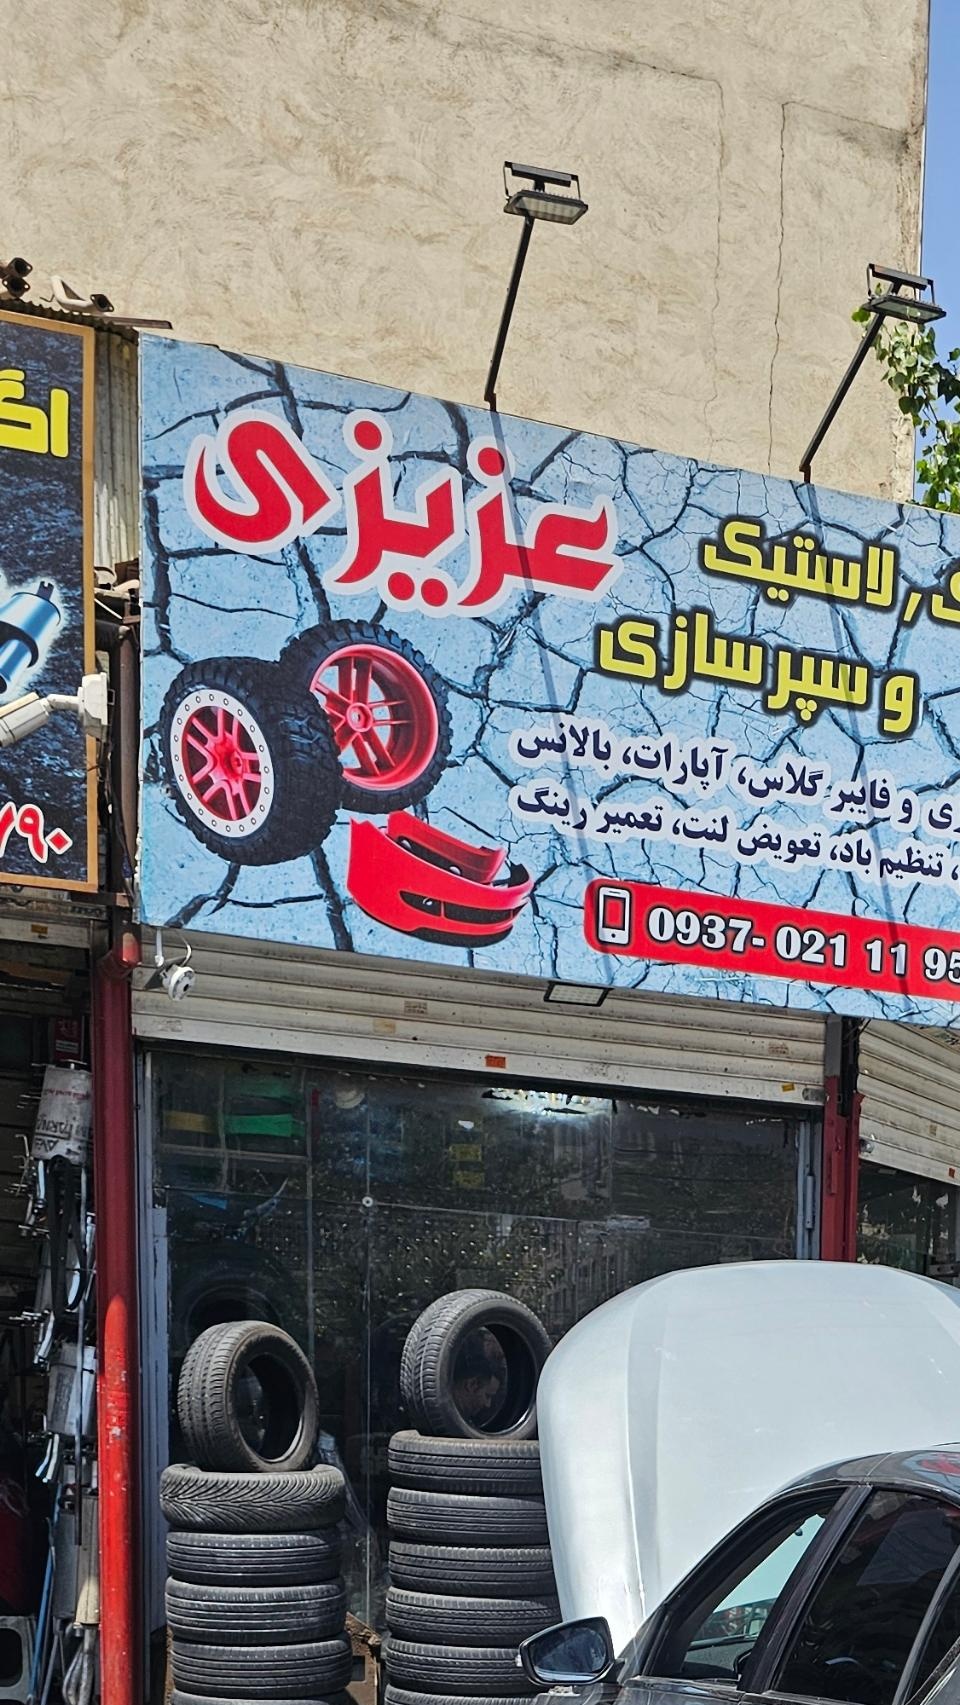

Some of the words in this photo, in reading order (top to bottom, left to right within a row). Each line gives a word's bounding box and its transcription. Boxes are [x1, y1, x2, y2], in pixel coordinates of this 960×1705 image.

[193, 418, 615, 608] عزیزی
[703, 520, 895, 607] لاستیک
[516, 722, 612, 771] بالانس
[516, 786, 588, 831] رینگ
[595, 804, 665, 835] تعمیر
[897, 793, 914, 824] و
[736, 823, 821, 864] تعویض
[879, 846, 944, 880] تنظیم
[774, 923, 847, 968] 021
[865, 937, 908, 976] 11
